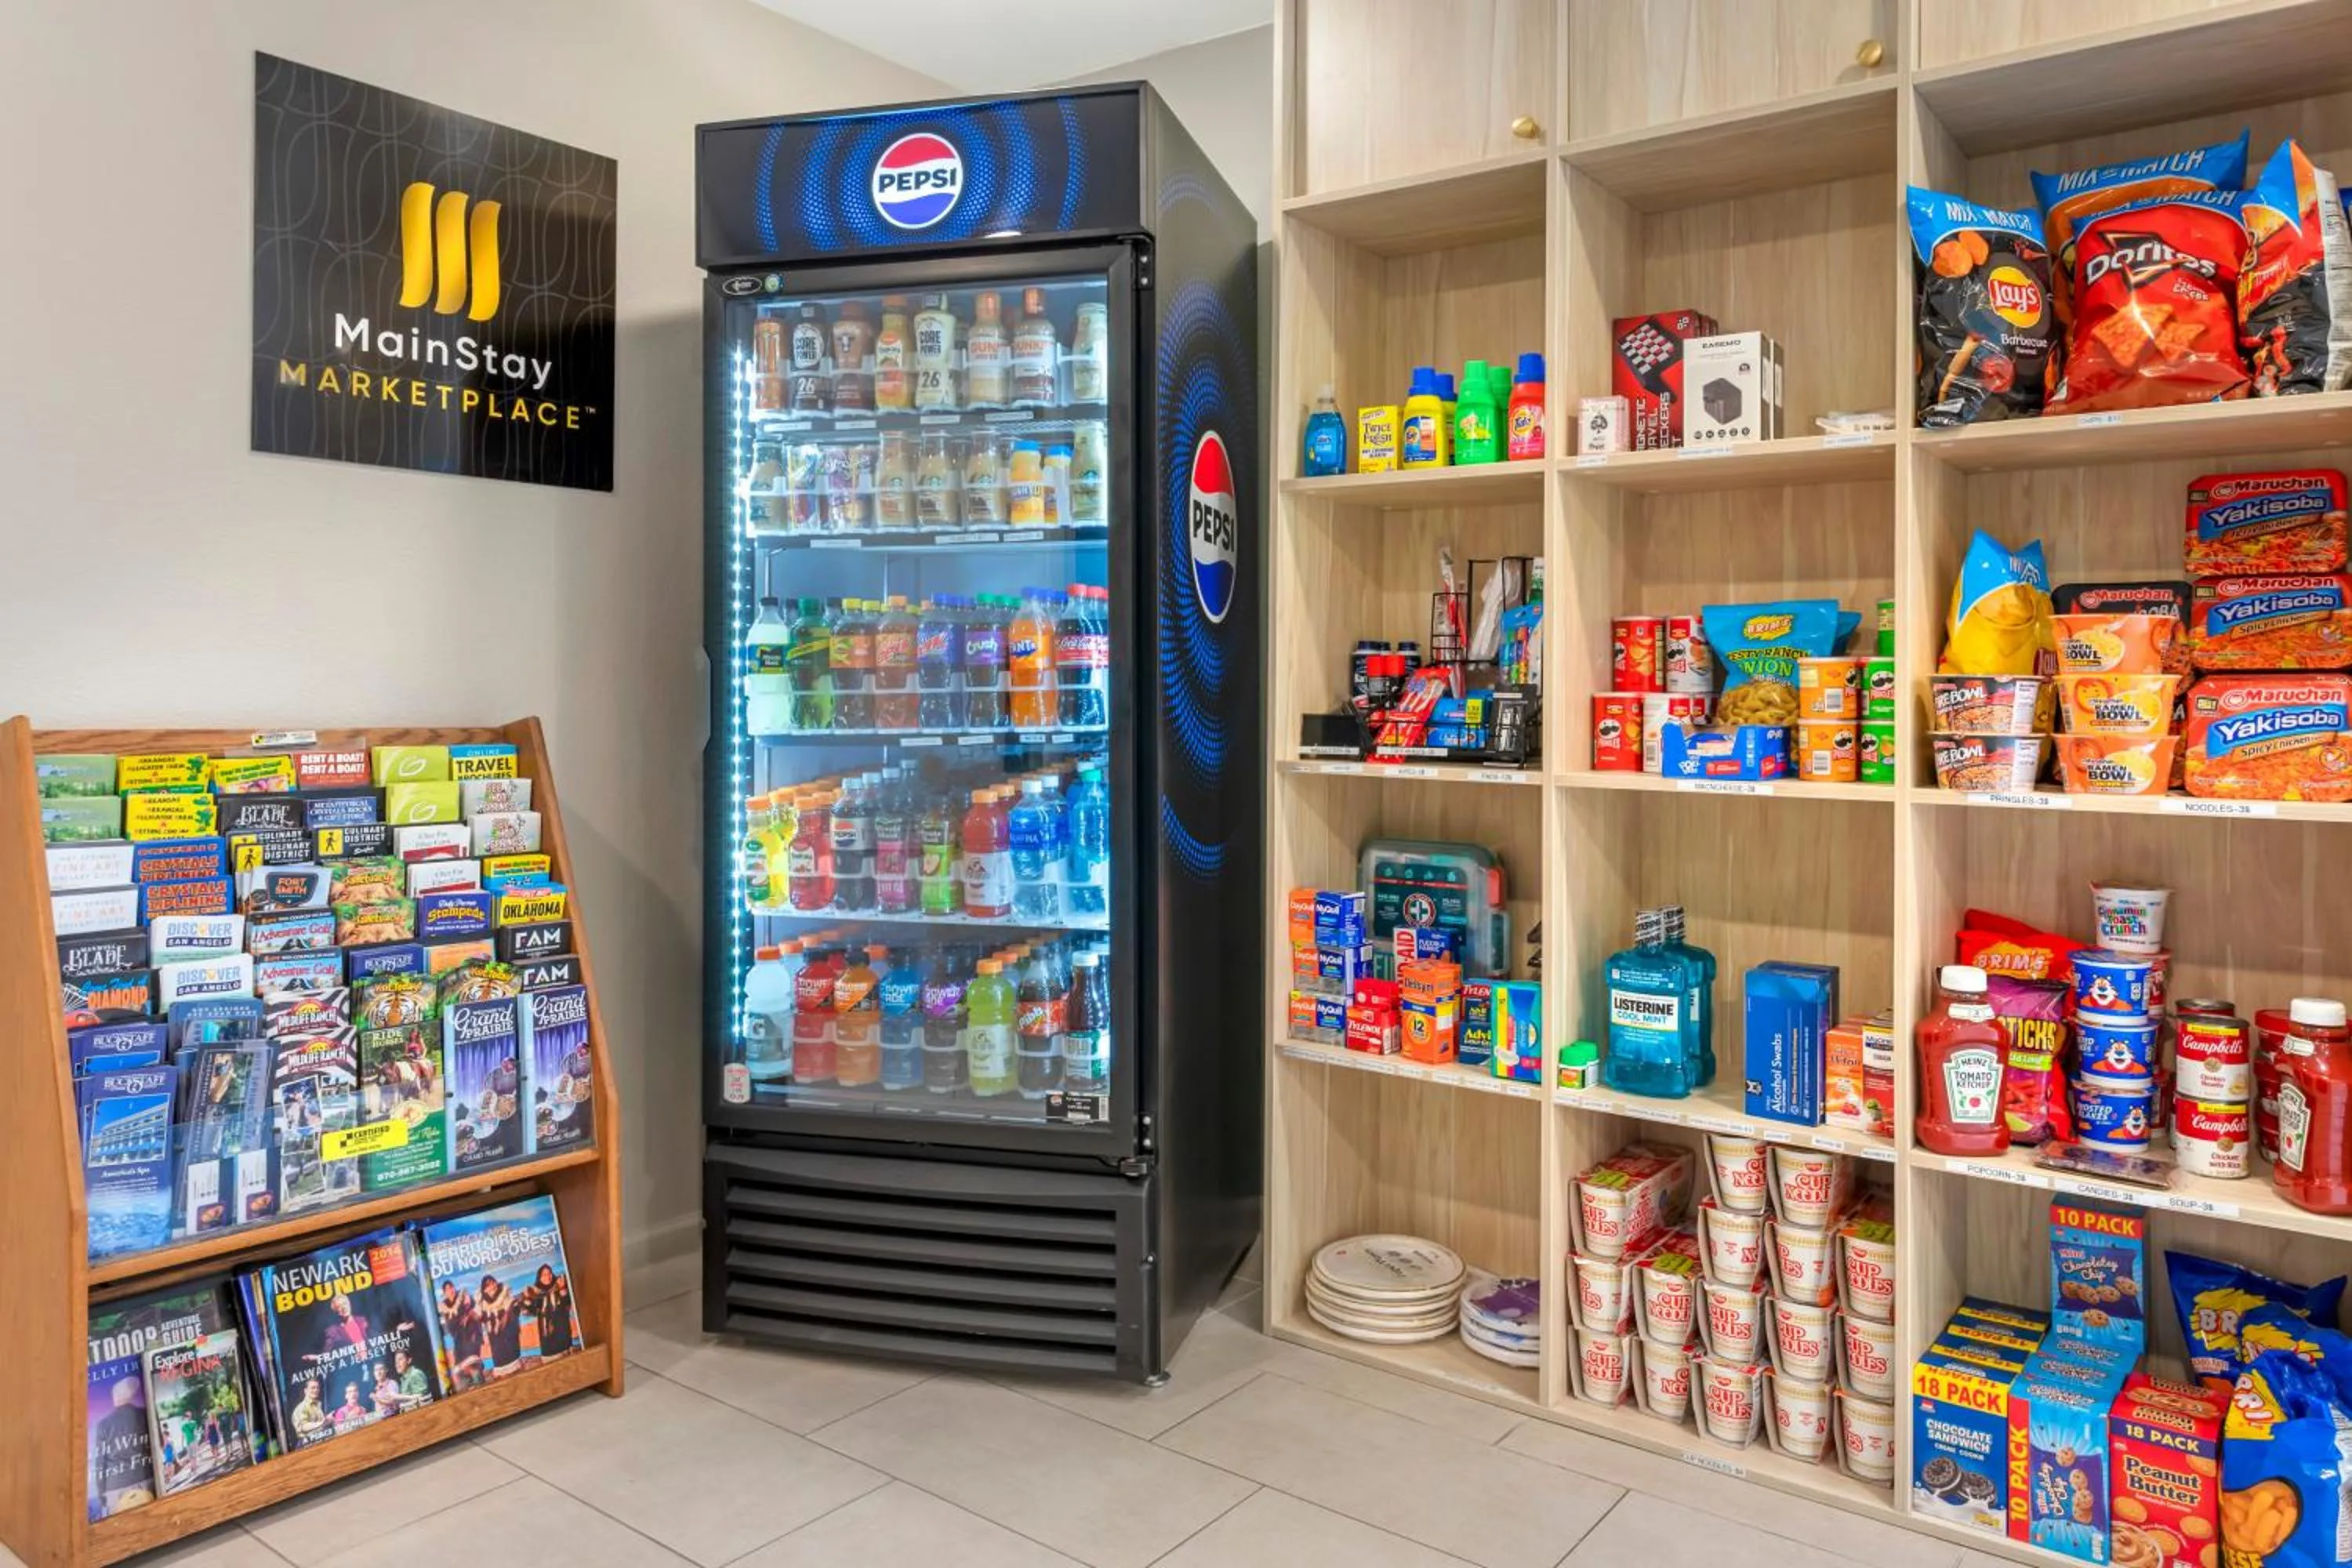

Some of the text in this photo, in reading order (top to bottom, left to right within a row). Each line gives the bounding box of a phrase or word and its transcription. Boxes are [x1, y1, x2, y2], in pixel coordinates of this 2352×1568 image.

[877, 166, 958, 194] PEPSI
[2086, 241, 2216, 285] Doritos
[2001, 333, 2049, 348] Barbecue
[334, 313, 552, 390] MainStay
[797, 377, 815, 393] 26
[921, 371, 940, 388] 26
[2235, 477, 2325, 493] Maruchan
[2210, 495, 2325, 527] Yakisoba
[1192, 499, 1236, 553] PEPSI
[2243, 577, 2335, 590] Maruchan
[2096, 590, 2173, 601] Maruchan
[2217, 593, 2334, 624] Yakisoba
[1743, 659, 1794, 677] NION
[1950, 686, 1987, 704] BOWL
[2246, 688, 2342, 702] Maruchan
[2096, 710, 2143, 720] BOWL
[2217, 710, 2339, 742] Yakisoba
[301, 753, 325, 764] RENT
[1950, 745, 1986, 763] BOWL
[301, 764, 325, 774] RENT
[456, 758, 512, 774] TRAVEL
[2088, 771, 2136, 781] BOWL
[345, 833, 386, 842] DISTRICT
[264, 849, 310, 860] DISTRICT
[503, 902, 561, 919] OKLAHOMA
[1316, 903, 1340, 916] NyQuil
[2101, 922, 2147, 936] Crunch
[1319, 954, 1343, 966] NyQuil
[87, 987, 147, 1009] DIAMOND
[1463, 984, 1491, 996] TYLEN
[1317, 1004, 1343, 1016] NyQuil
[1614, 996, 1675, 1016] LISTERINE
[1414, 1018, 1425, 1032] 12
[1617, 1011, 1668, 1025] COOL MINT
[1347, 1020, 1382, 1036] TYLENOL
[2182, 1033, 2244, 1055] Campbell's
[1961, 1058, 1988, 1069] HEINZ
[1770, 1033, 1782, 1113] Alcohol Swabs
[1953, 1071, 1993, 1083] TOMATO
[1956, 1080, 1991, 1090] KETCHUP
[2169, 1196, 2214, 1212] SOUP-3$
[2057, 1208, 2136, 1237] 10 PACK
[272, 1251, 369, 1294] NEWARK
[432, 1263, 454, 1279] DU
[276, 1271, 373, 1314] BOUND
[316, 1330, 402, 1365] FRANKIE VALLI
[291, 1362, 335, 1385] ALWAYS
[390, 1338, 412, 1352] BOY
[1917, 1375, 2002, 1414] 18 PACK
[1926, 1418, 1993, 1444] CHOCOLATE
[2125, 1423, 2200, 1453] 18 PACK
[1927, 1428, 1991, 1454] SANDWICH
[2009, 1425, 2030, 1522] 10 PACK
[2124, 1455, 2200, 1490] Peanut
[2128, 1475, 2200, 1506] Butter
